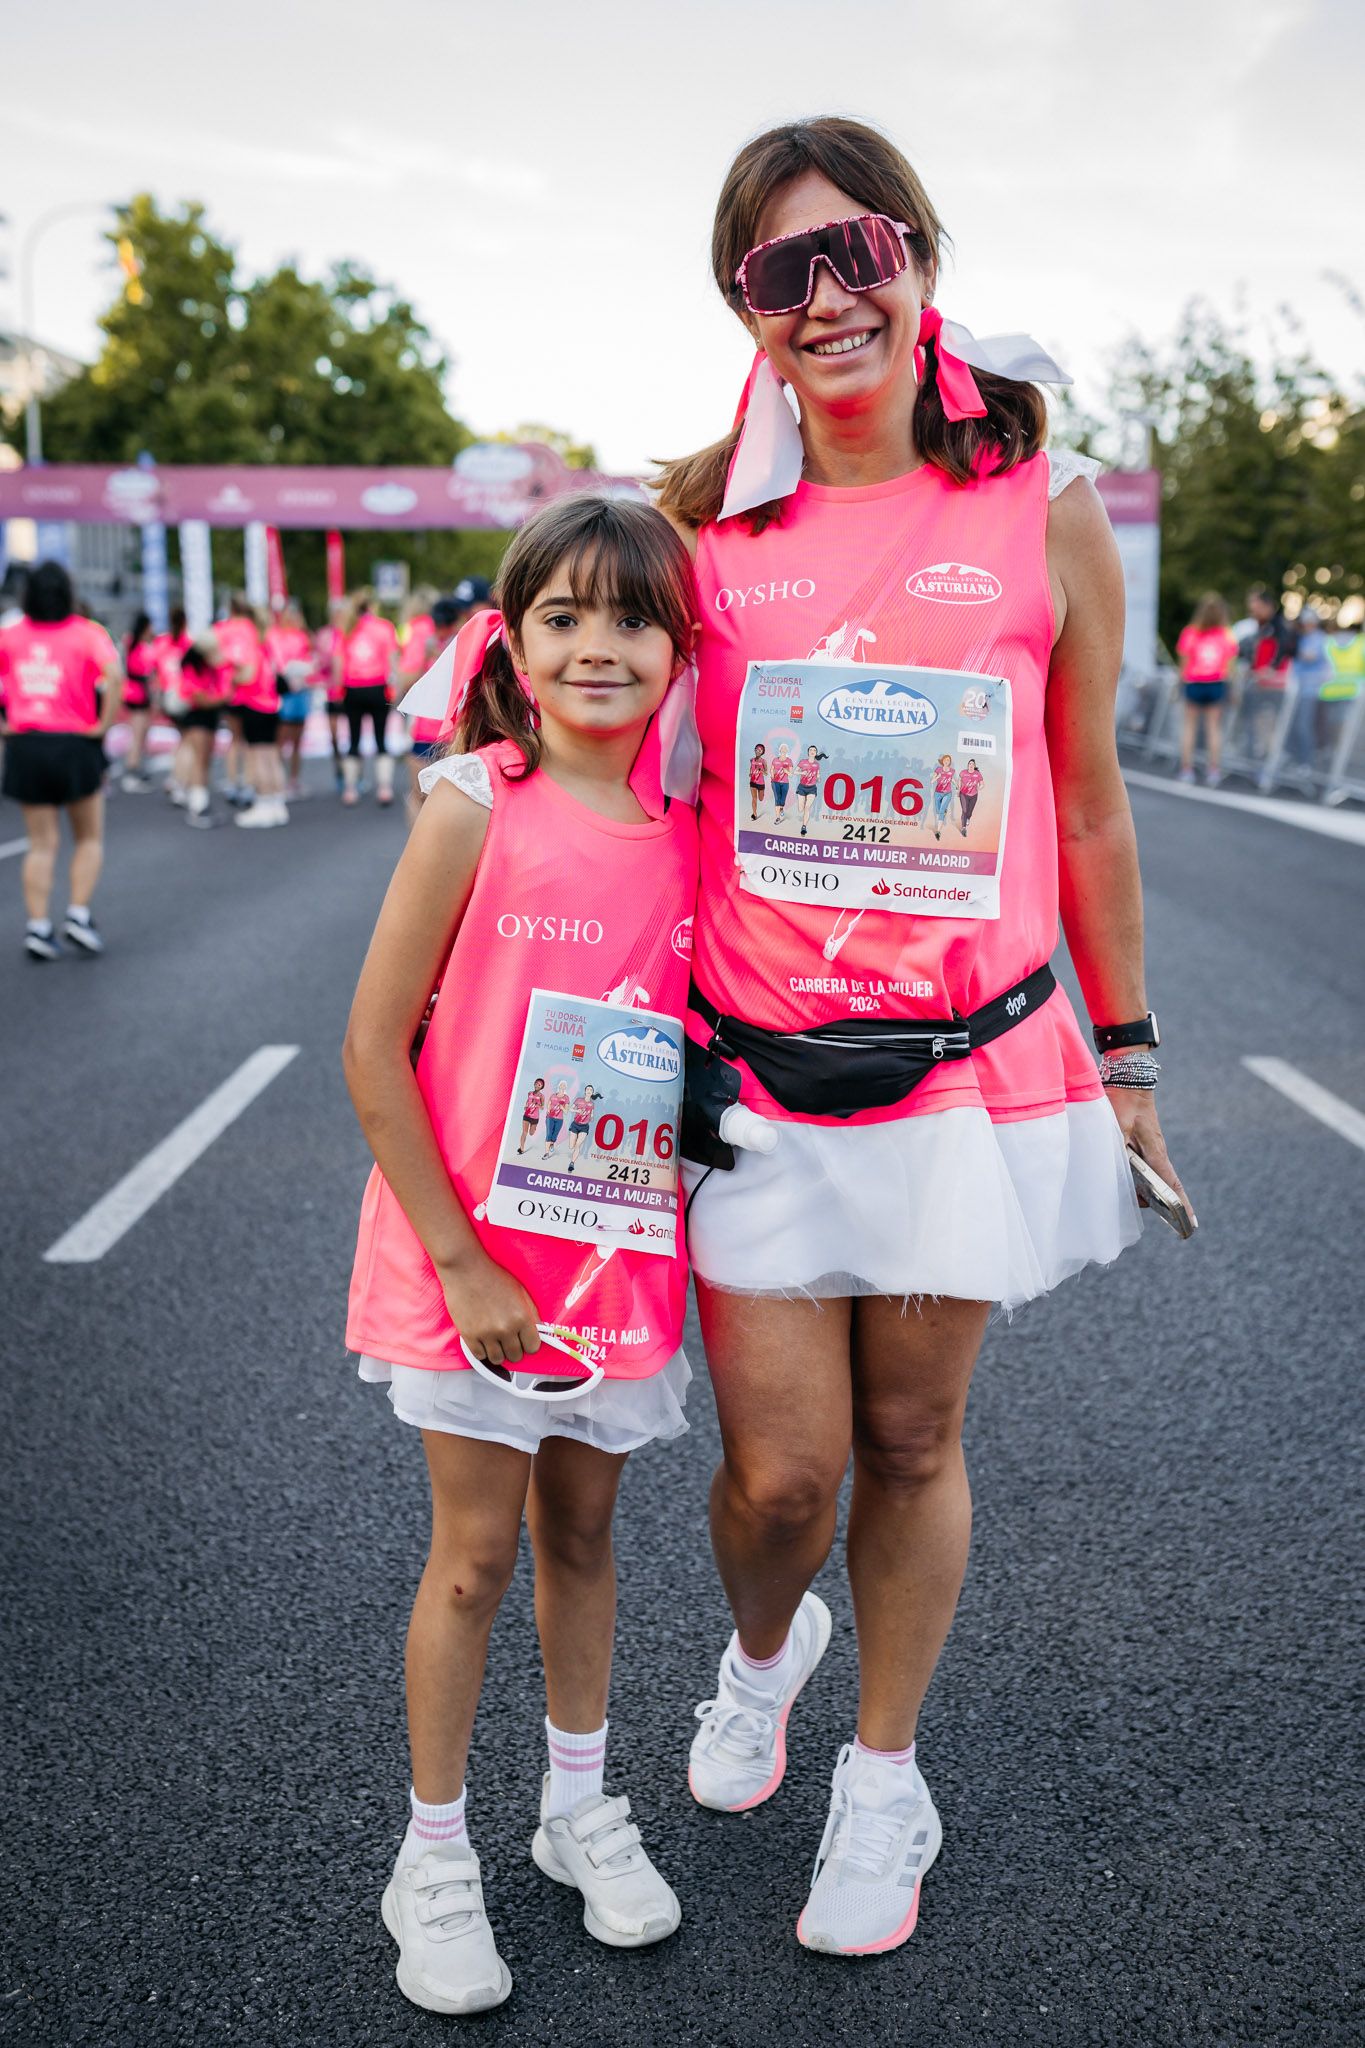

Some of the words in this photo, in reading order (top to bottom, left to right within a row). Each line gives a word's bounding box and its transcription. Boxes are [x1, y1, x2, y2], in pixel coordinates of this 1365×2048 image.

[715, 578, 816, 612] OYSHO
[913, 577, 996, 597] ASTURIANA
[758, 684, 801, 699] SUMA
[771, 677, 803, 686] DORSAL
[826, 697, 929, 726] ASTURIANA
[823, 772, 924, 817] 016
[842, 823, 891, 843] 2412
[764, 838, 819, 857] CARRERA
[822, 845, 840, 859] DE
[843, 846, 860, 860] LA
[863, 848, 908, 864] MUJER
[919, 852, 971, 868] MADRID
[761, 865, 839, 891] OYSHO
[893, 882, 972, 901] Santander
[497, 913, 604, 945] OYSHO
[789, 977, 848, 994] CARRERA
[851, 979, 867, 993] DE
[868, 980, 885, 996] LA
[888, 980, 934, 997] MUJER
[848, 996, 881, 1012] 2024
[545, 1009, 557, 1018] TU
[558, 1011, 587, 1024] DORSAL
[543, 1018, 584, 1037] SUMA
[603, 1040, 678, 1074] ASTURIANA
[594, 1113, 674, 1160] 016
[607, 1164, 651, 1185] 2413
[526, 1173, 583, 1194] CARRERA
[586, 1183, 603, 1197] DE
[605, 1186, 620, 1200] LA
[624, 1188, 662, 1206] MUJER
[517, 1199, 598, 1228] OYSHO
[581, 1325, 598, 1342] DE
[601, 1327, 617, 1344] LA
[575, 1343, 607, 1361] 2024
